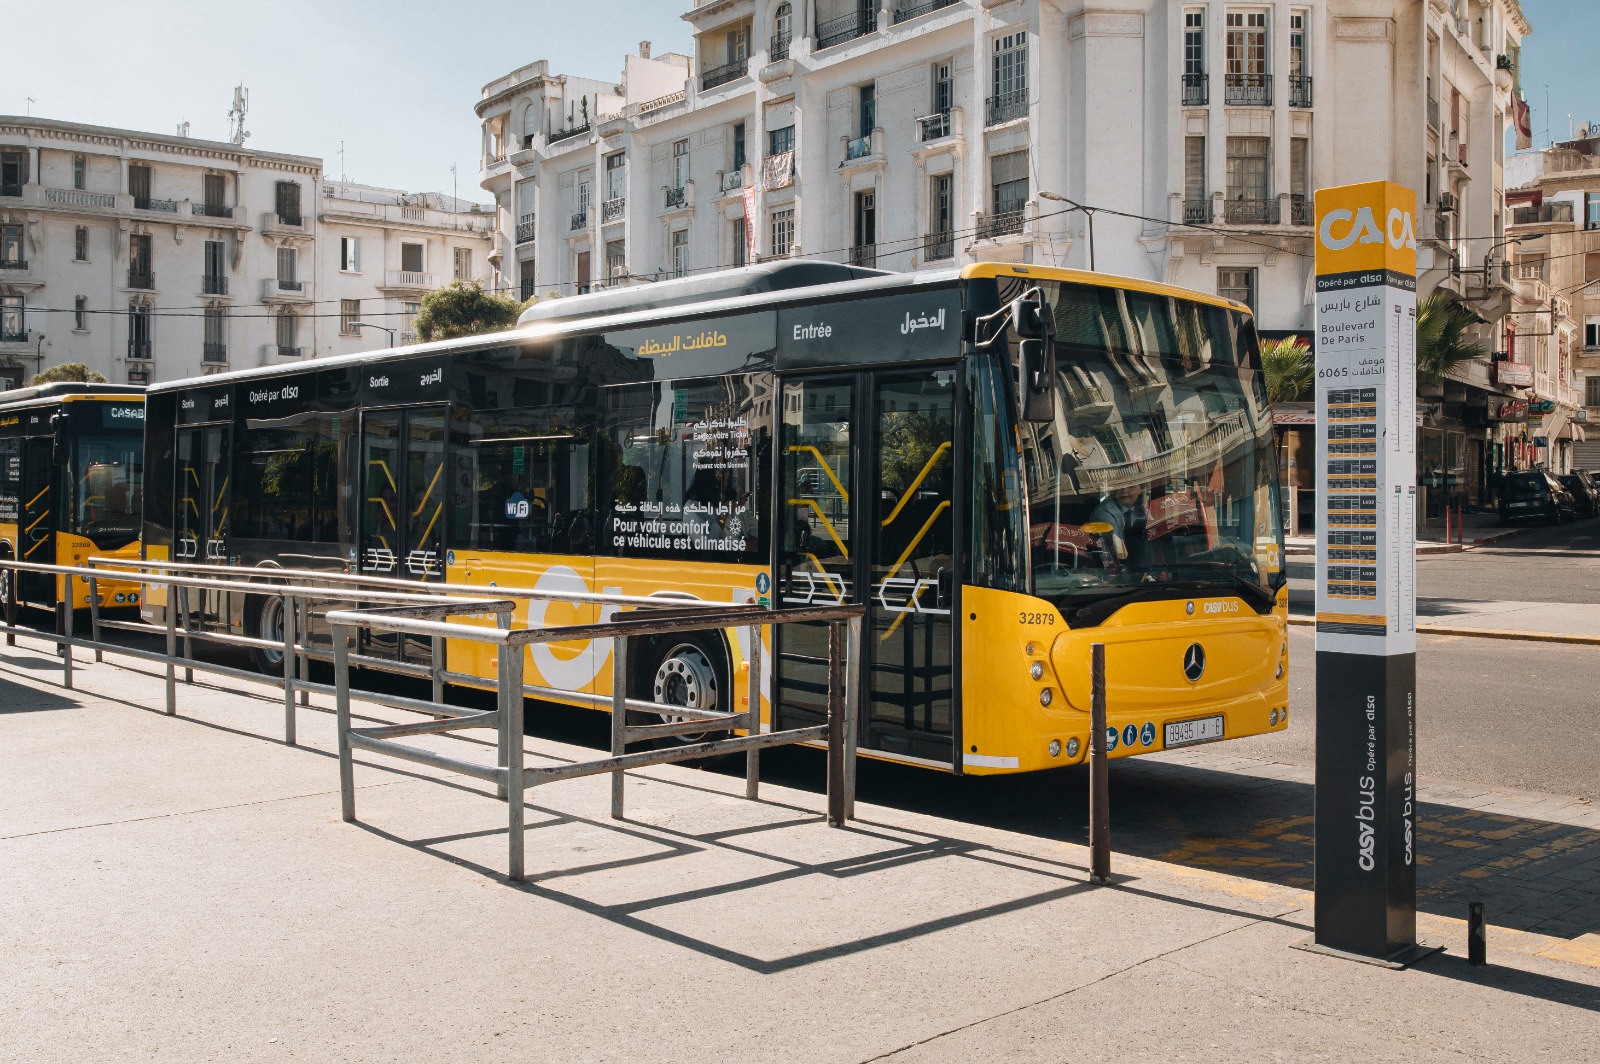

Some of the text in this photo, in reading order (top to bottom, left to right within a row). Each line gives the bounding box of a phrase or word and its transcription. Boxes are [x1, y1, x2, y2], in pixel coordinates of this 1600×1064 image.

[1318, 274, 1382, 289] Opéré par alsa
[1404, 279, 1416, 289] alsa
[1320, 298, 1351, 314] باريس
[1354, 295, 1381, 313] شارع
[900, 308, 946, 335] الدخول
[1321, 319, 1375, 333] Boulevard
[793, 322, 832, 341] Entrée
[1321, 333, 1365, 346] De Paris
[638, 330, 727, 357] حافلات البيضاء
[1358, 357, 1385, 367] موقف
[420, 367, 442, 386] الخروج
[1318, 367, 1348, 378] 6065
[1351, 366, 1385, 376] الحافلات
[369, 375, 389, 388] Sortie
[249, 385, 299, 404] Opéré par alsa
[613, 517, 710, 535] Pour votre confort
[613, 533, 747, 552] ce véhicule est climatisé
[1019, 612, 1055, 625] 32879
[1365, 695, 1375, 720] alsa
[1368, 724, 1377, 740] par
[1367, 742, 1377, 771] Opéré
